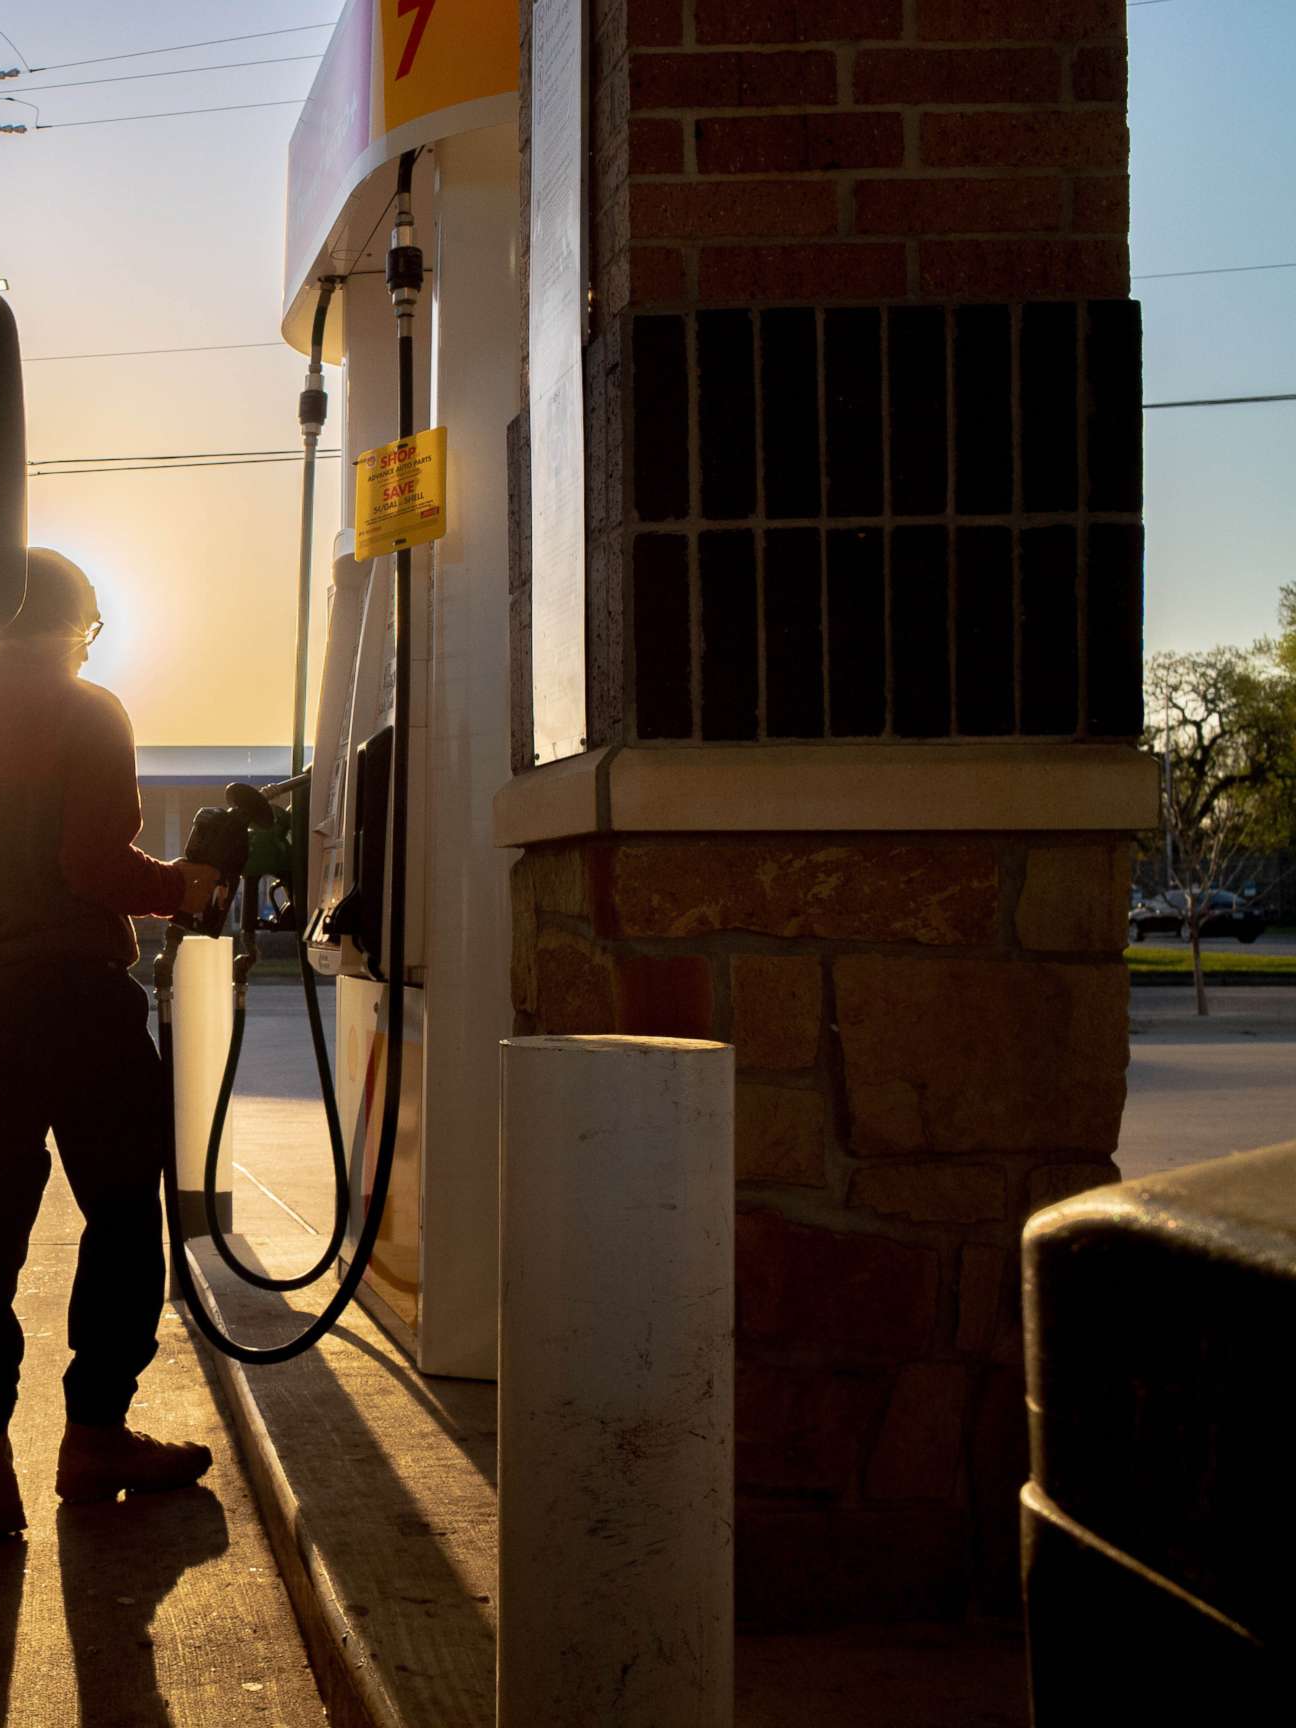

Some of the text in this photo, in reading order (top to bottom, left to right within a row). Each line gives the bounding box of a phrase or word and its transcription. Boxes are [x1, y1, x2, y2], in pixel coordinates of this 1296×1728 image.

[396, 0, 436, 81] 7
[367, 467, 394, 482] ADVANCE
[396, 462, 414, 473] AUTO
[414, 455, 432, 468] PARTS
[380, 447, 416, 469] SHOP
[383, 480, 415, 502] SAVE
[404, 491, 425, 504] SHELL
